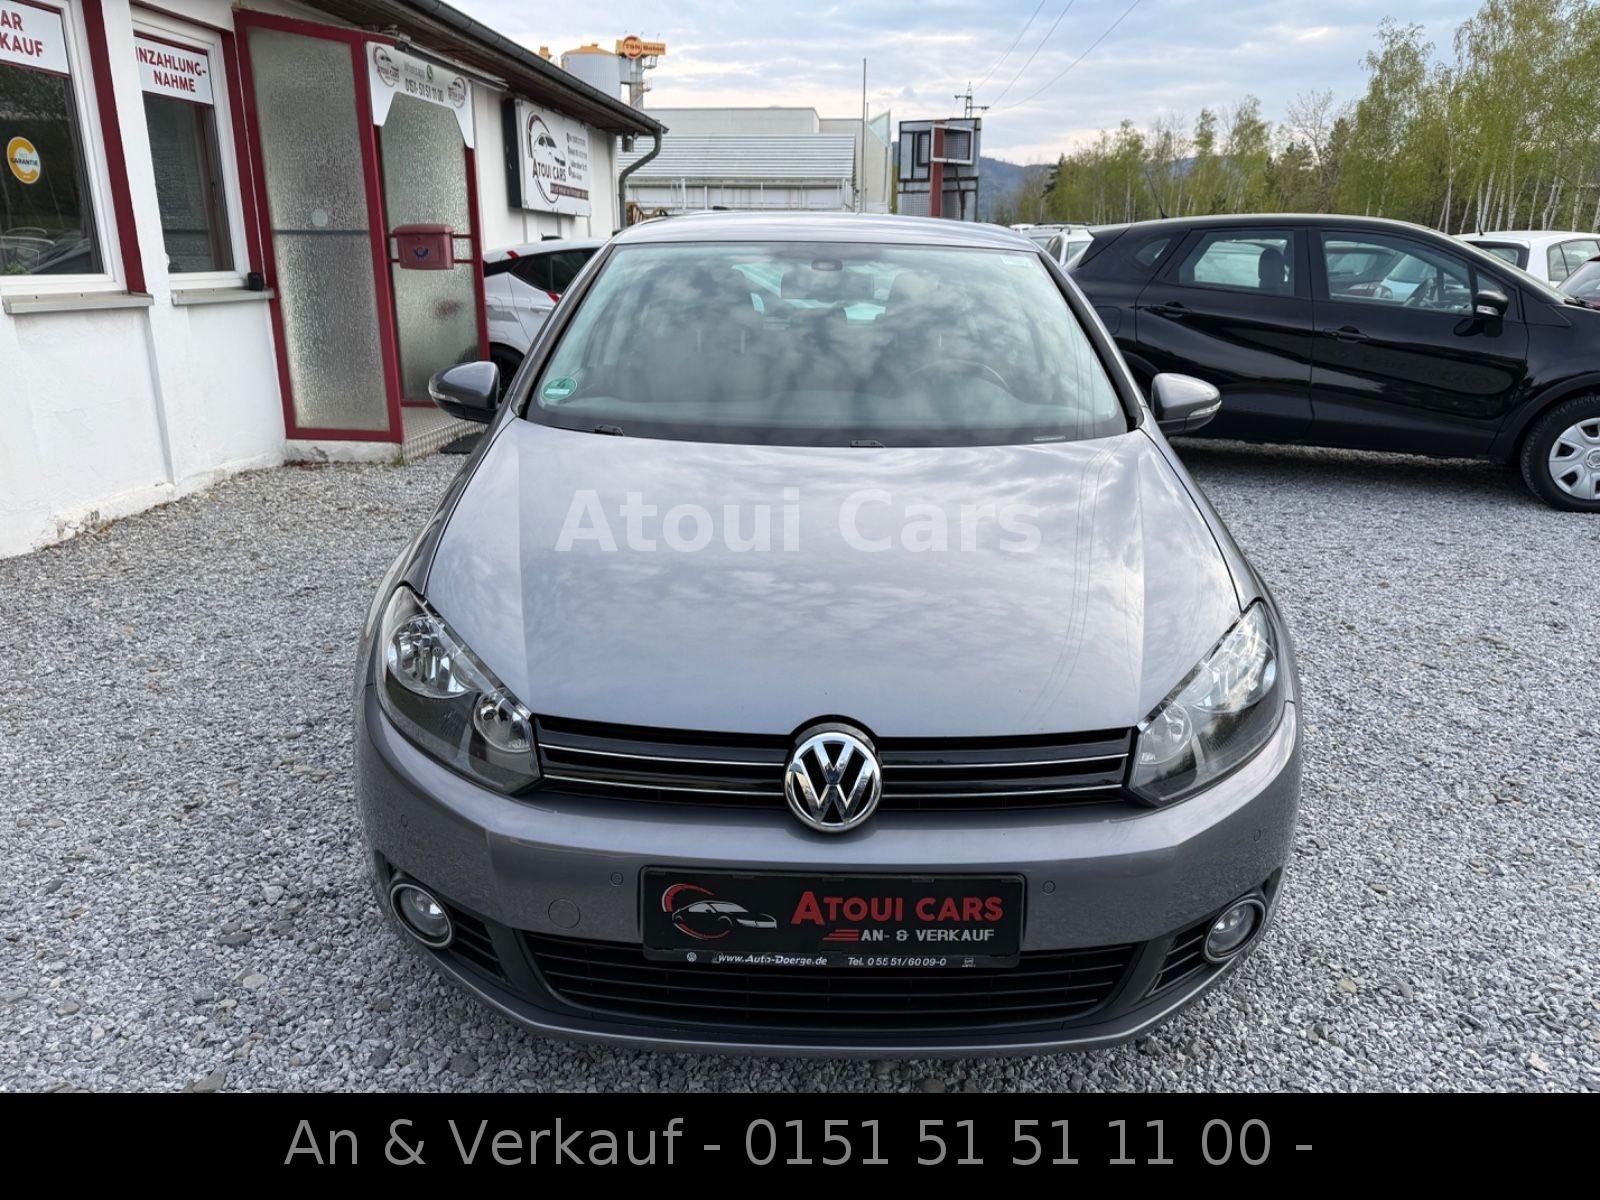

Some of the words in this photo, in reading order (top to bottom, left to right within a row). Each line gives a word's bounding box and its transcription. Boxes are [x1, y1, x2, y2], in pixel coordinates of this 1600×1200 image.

[153, 70, 196, 93] NAHME
[552, 165, 567, 182] CARS
[791, 891, 903, 925] ATOUI
[915, 897, 1004, 922] CARS
[861, 929, 890, 942] AN-
[916, 929, 995, 942] VERKAUF
